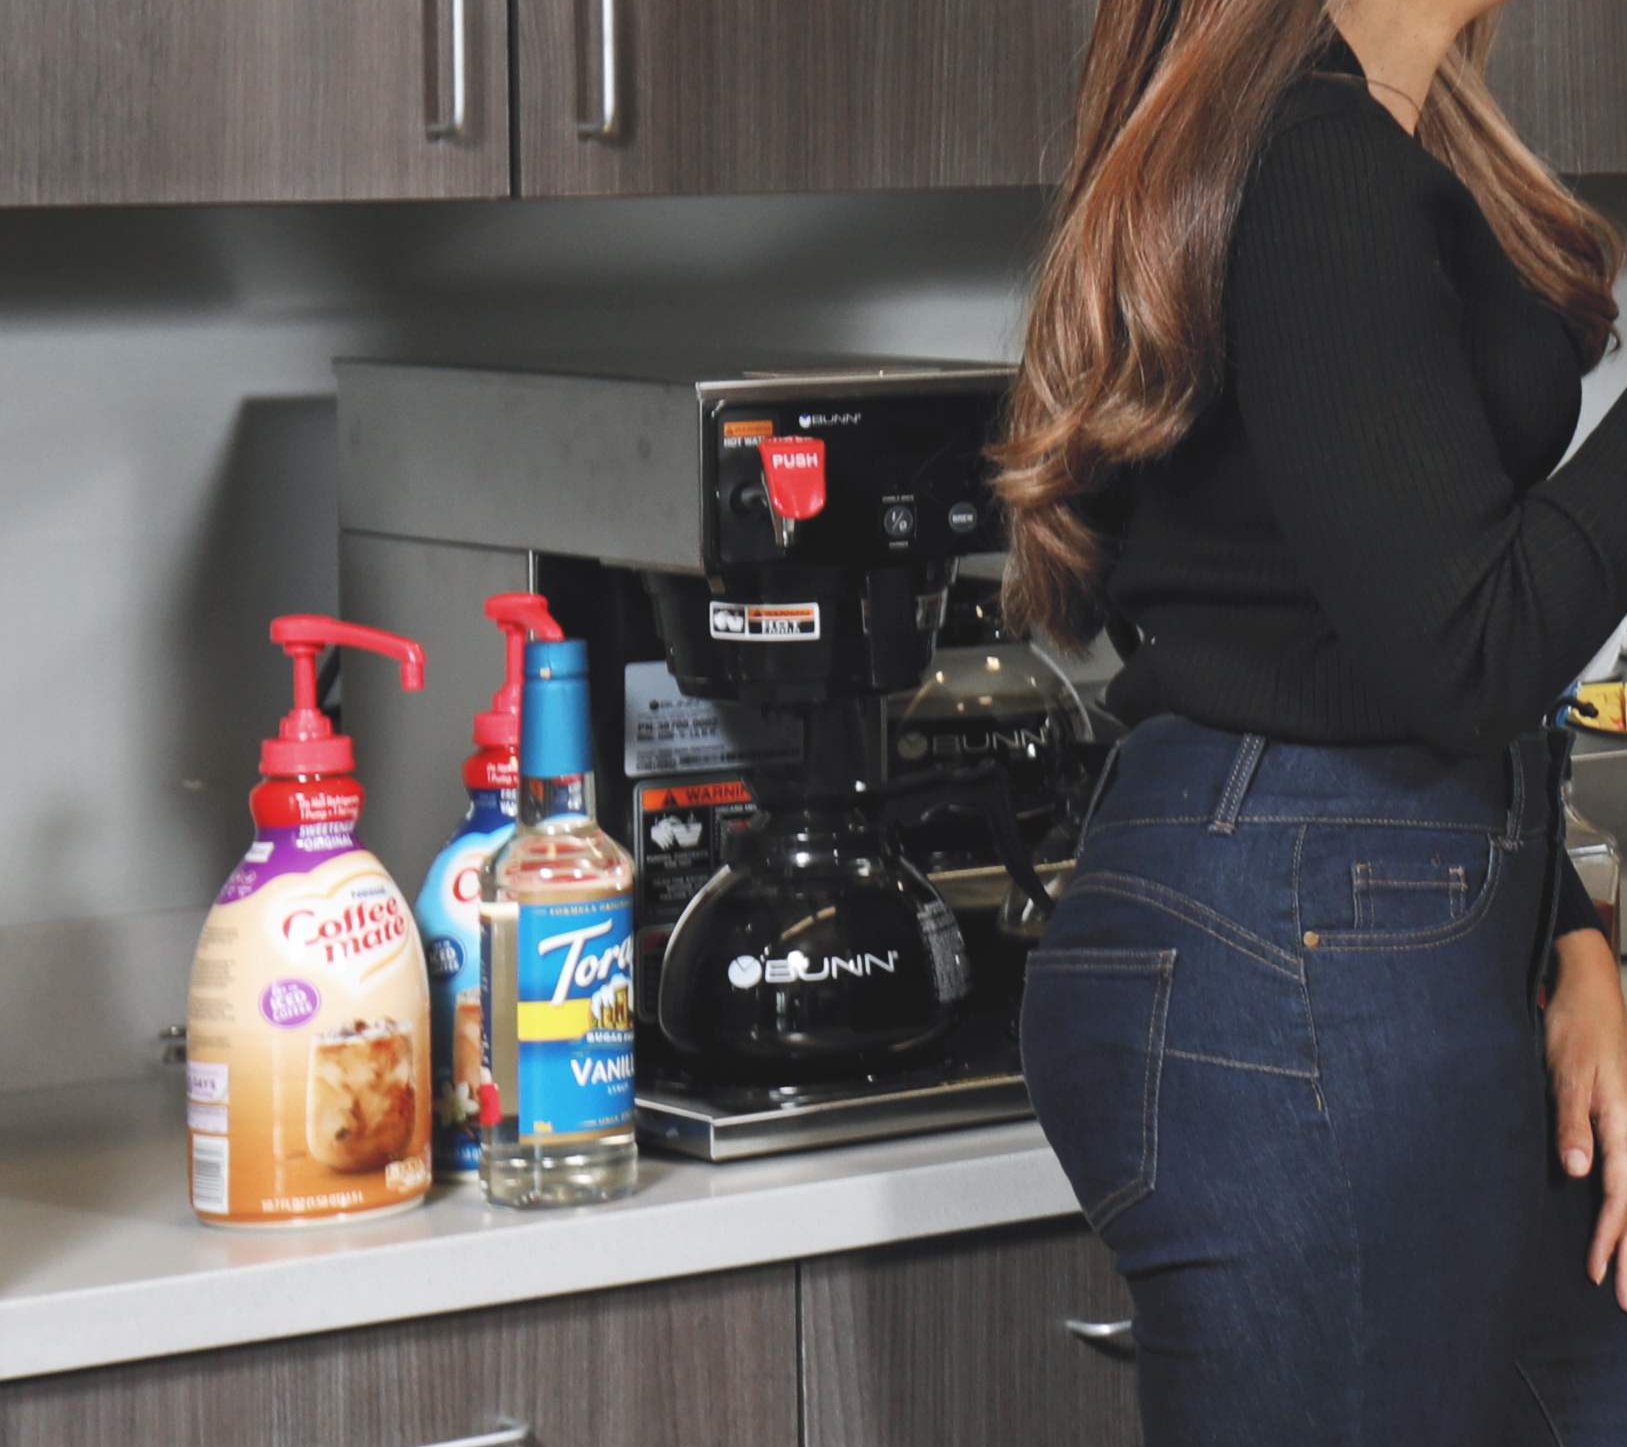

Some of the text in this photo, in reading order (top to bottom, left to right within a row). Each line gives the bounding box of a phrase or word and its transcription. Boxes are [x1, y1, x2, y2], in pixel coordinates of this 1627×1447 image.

[811, 413, 859, 427] BUNN
[724, 437, 742, 448] HOT
[772, 453, 818, 469] PUSH
[282, 897, 397, 945] Coffee
[326, 915, 405, 962] mate
[766, 951, 896, 984] BUNN
